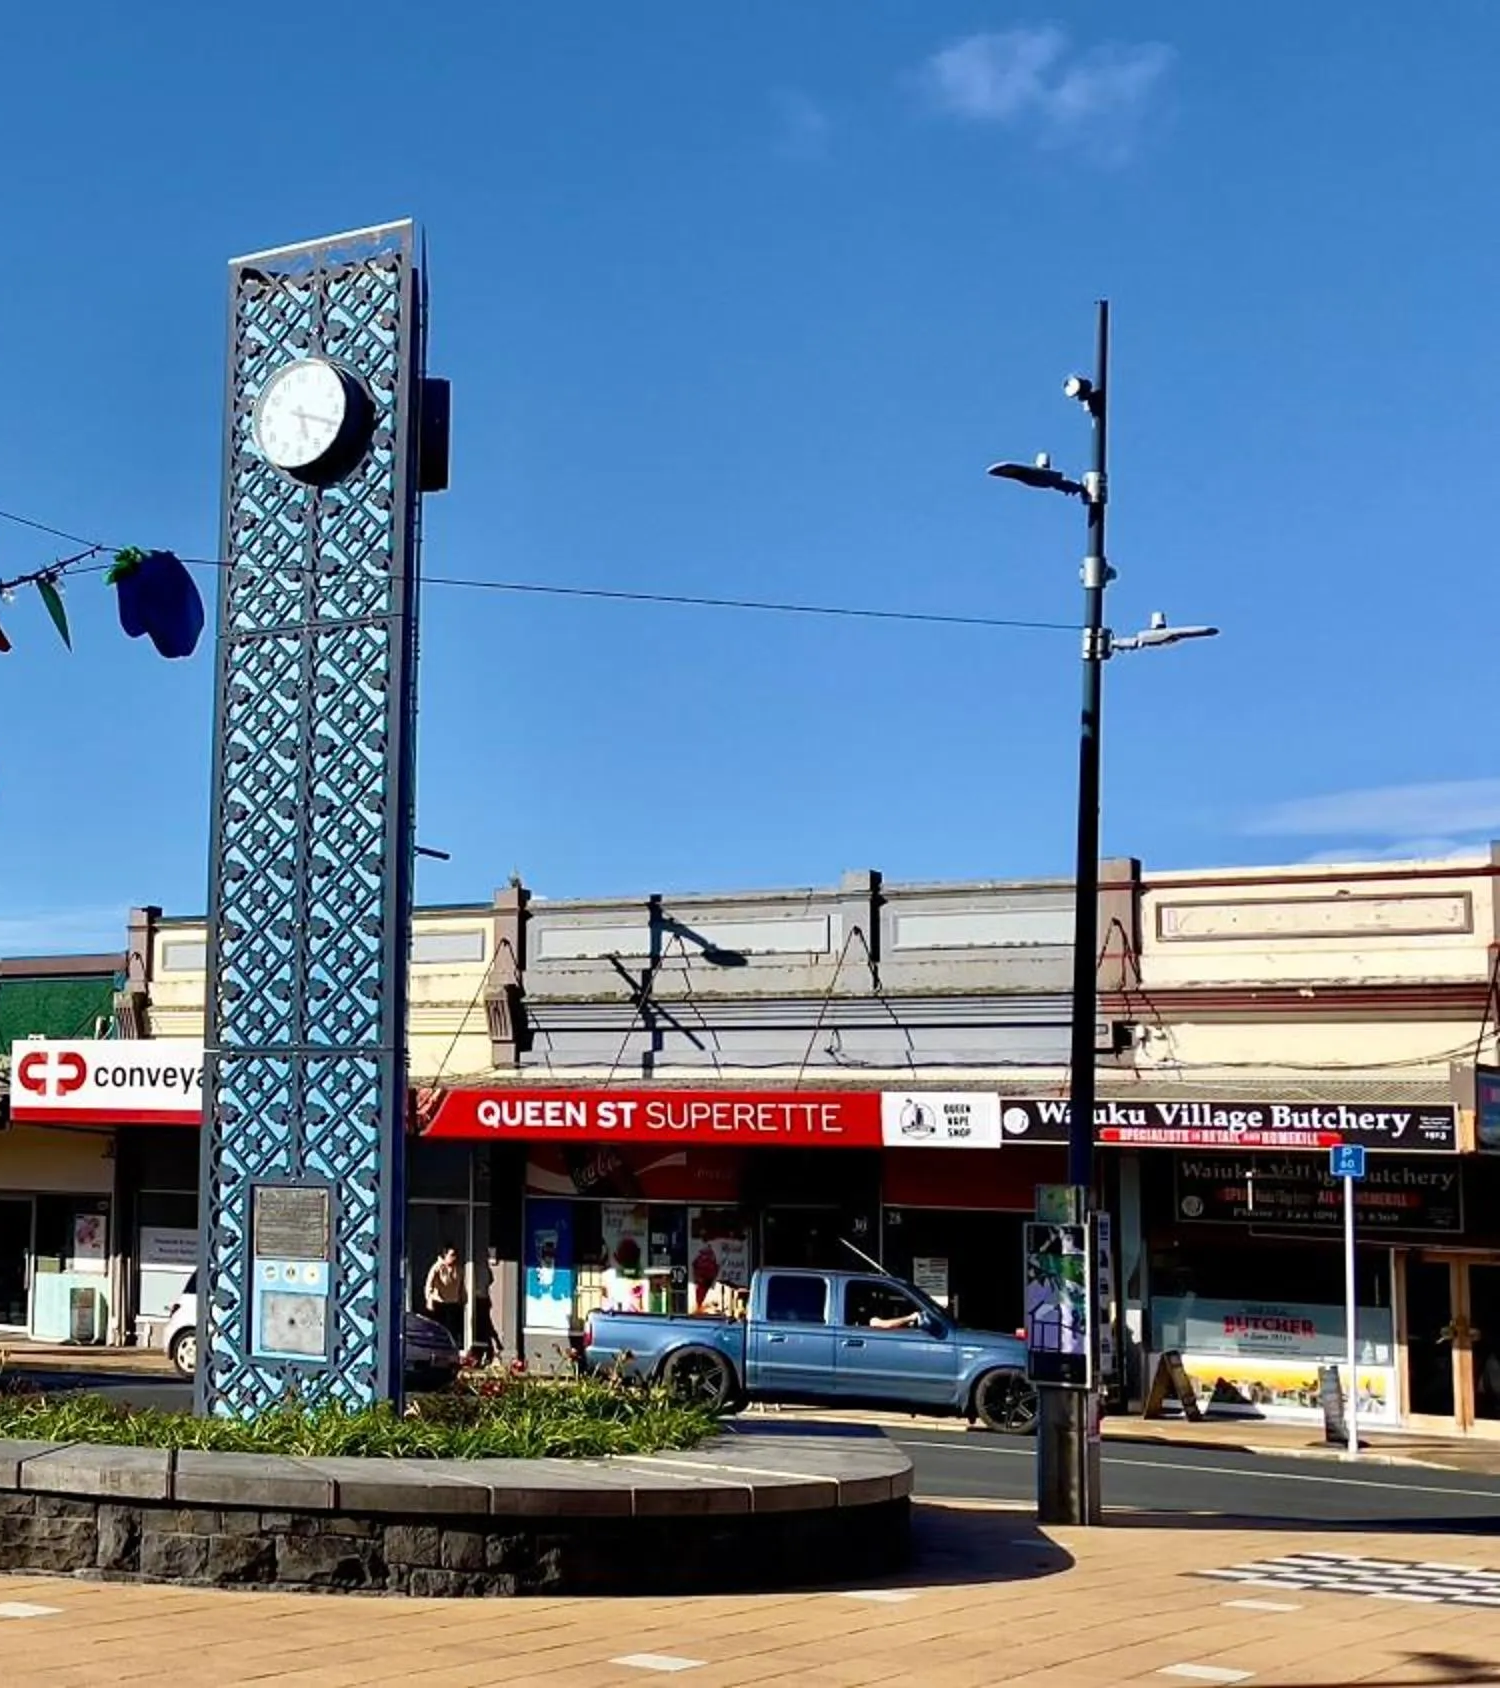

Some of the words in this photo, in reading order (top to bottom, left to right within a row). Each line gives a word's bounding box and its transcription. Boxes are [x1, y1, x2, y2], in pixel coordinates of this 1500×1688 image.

[477, 1099, 587, 1129] QUEEN
[596, 1101, 638, 1129] ST
[645, 1100, 844, 1133] SUPERETTE
[943, 1103, 971, 1115] QUEEN
[1036, 1101, 1147, 1126] Wuku
[1156, 1103, 1263, 1131] Village
[1270, 1105, 1412, 1138] Butchery
[947, 1127, 972, 1138] SHOP
[1341, 1147, 1353, 1158] P
[1223, 1315, 1317, 1338] BUTCHER
